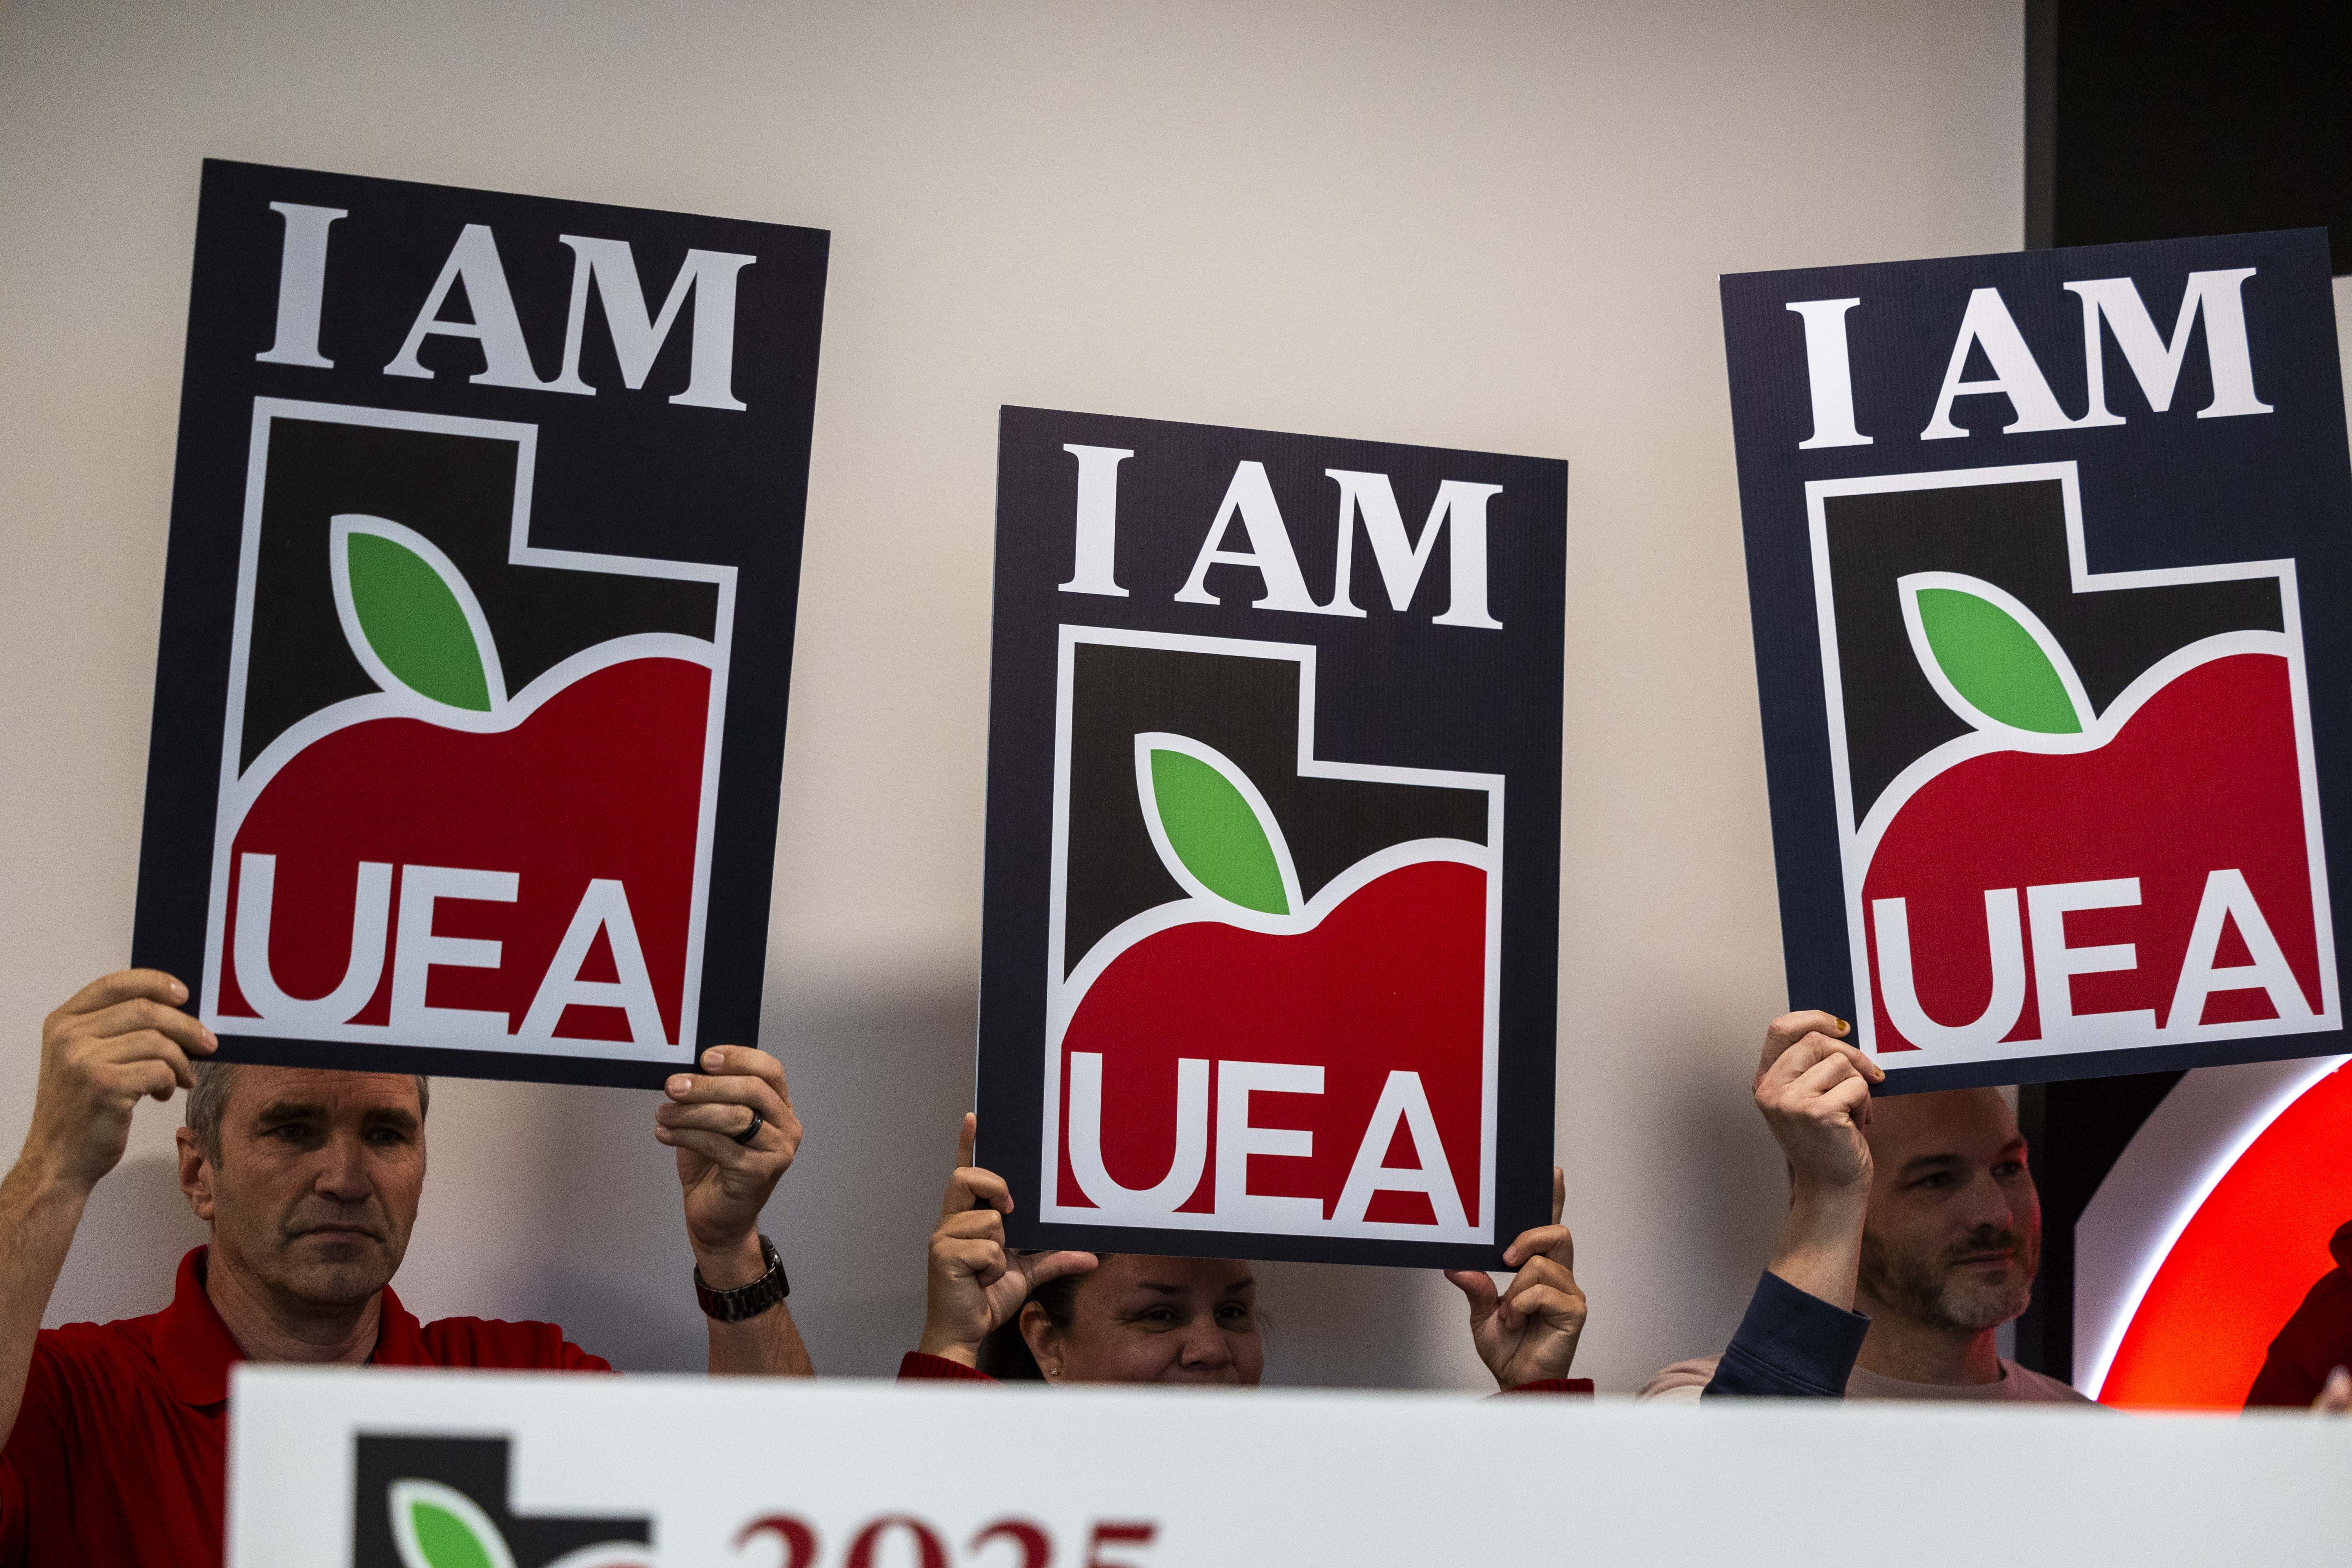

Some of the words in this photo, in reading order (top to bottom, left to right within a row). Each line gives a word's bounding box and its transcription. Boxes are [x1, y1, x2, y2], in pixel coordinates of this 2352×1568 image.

[256, 202, 347, 368] I
[384, 224, 756, 411] AM
[1786, 298, 1873, 450] I
[1920, 267, 2274, 440] AM
[1058, 443, 1134, 597] I
[1174, 461, 1503, 630] AM
[234, 852, 670, 1053] UEA
[1872, 868, 2316, 1056] UEA
[1068, 1051, 1471, 1231] UEA
